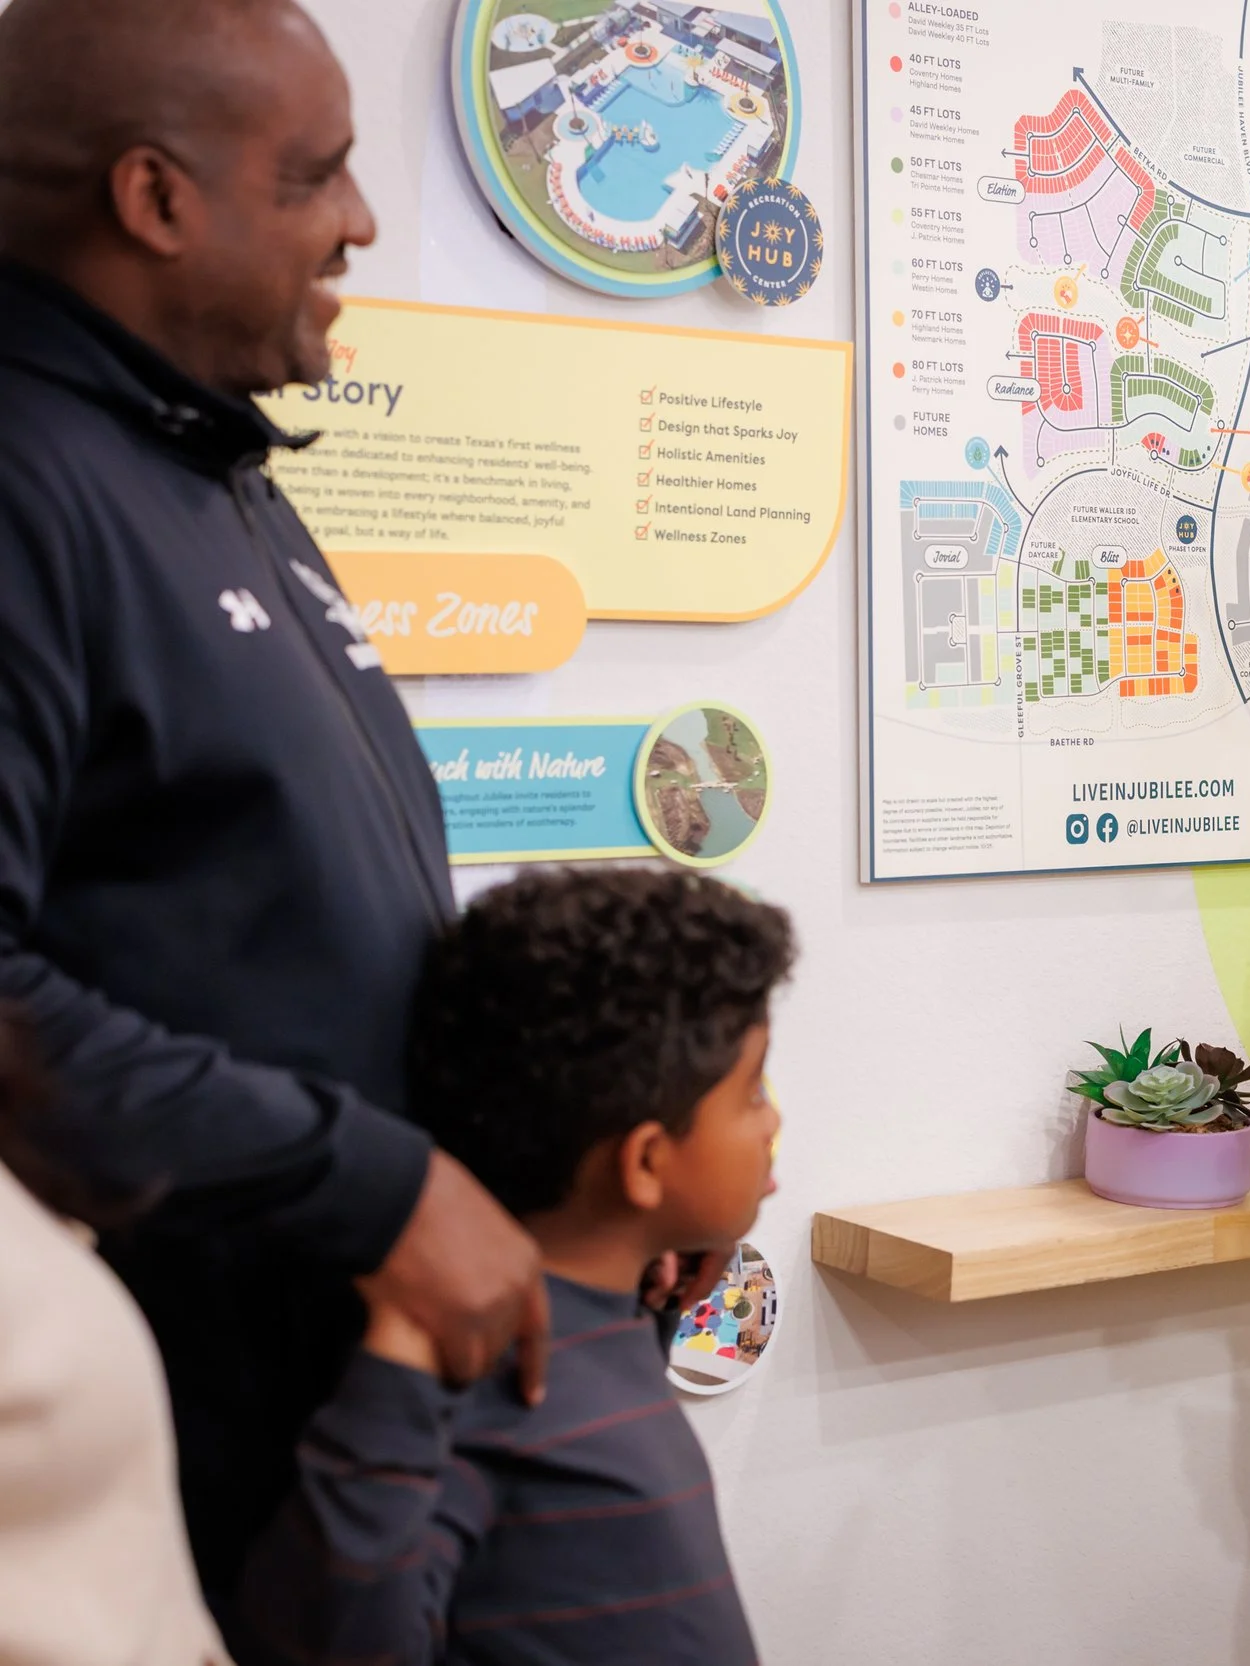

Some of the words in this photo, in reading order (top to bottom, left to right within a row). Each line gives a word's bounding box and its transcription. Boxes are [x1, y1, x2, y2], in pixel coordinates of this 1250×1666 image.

[908, 2, 979, 21] ALLEY-LOADED
[908, 16, 925, 26] David
[927, 18, 954, 31] Weekley
[956, 23, 964, 31] 35
[966, 25, 974, 33] FT
[975, 27, 989, 36] Lots
[909, 54, 922, 64] 40
[924, 56, 935, 66] FT
[937, 57, 961, 69] LOTS
[909, 68, 939, 81] Coventry
[941, 72, 962, 83] Homes
[1120, 67, 1144, 77] FUTURE
[1110, 76, 1154, 88] MULTI-FAMILY
[910, 106, 922, 116] 45
[924, 107, 935, 117] FT
[937, 109, 961, 121] LOTS
[1239, 112, 1247, 146] HAVEN
[1193, 146, 1216, 154] FUTURE
[910, 157, 922, 167] 50
[925, 159, 936, 168] FT
[938, 160, 962, 172] LOTS
[1133, 147, 1154, 170] BETKA
[1155, 168, 1168, 180] RD
[1184, 154, 1225, 166] COMMERCIAL
[987, 183, 1016, 197] Elation
[748, 195, 800, 218] RECREATION
[911, 208, 923, 218] 55
[925, 210, 936, 219] FT
[938, 211, 962, 222] LOTS
[748, 244, 793, 268] HUB
[912, 259, 924, 268] 60
[926, 261, 936, 270] FT
[939, 262, 963, 272] LOTS
[752, 275, 786, 288] CENTER
[912, 310, 923, 320] 70
[926, 311, 936, 321] FT
[939, 312, 962, 323] LOTS
[912, 360, 924, 370] 80
[926, 362, 937, 372] FT
[939, 362, 963, 372] LOTS
[995, 383, 1034, 396] Radiance
[659, 392, 708, 407] Positive
[712, 397, 762, 413] Lifestyle
[913, 412, 950, 422] FUTURE
[658, 420, 700, 436] Design
[704, 424, 730, 436] that
[734, 425, 773, 440] Sparks
[776, 428, 799, 444] Joy
[914, 426, 948, 437] HOMES
[658, 448, 702, 461] Holistic
[706, 451, 766, 465] Amenities
[656, 474, 714, 488] Healthier
[717, 478, 757, 491] Homes
[1110, 468, 1141, 484] JOYFUL
[1142, 477, 1159, 491] LIFE
[1160, 486, 1170, 498] DR
[655, 502, 723, 516] Intentional
[726, 506, 756, 518] Land
[760, 507, 810, 524] Planning
[1073, 506, 1096, 514] FUTURE
[1099, 506, 1124, 514] WALLER
[1072, 516, 1112, 524] ELEMENTARY
[655, 530, 706, 542] Wellness
[710, 532, 746, 544] Zones
[933, 551, 960, 563] Jovial
[1101, 551, 1120, 563] Bliss
[426, 592, 538, 638] Zones
[1016, 636, 1022, 647] ST
[1016, 651, 1024, 687] GROVE
[1083, 738, 1094, 746] RD
[475, 747, 524, 780] with
[528, 751, 606, 780] Nature
[1073, 779, 1234, 802] LIVEINJUBILEE.COM
[1127, 816, 1240, 837] @LIVEINJUBILEE
